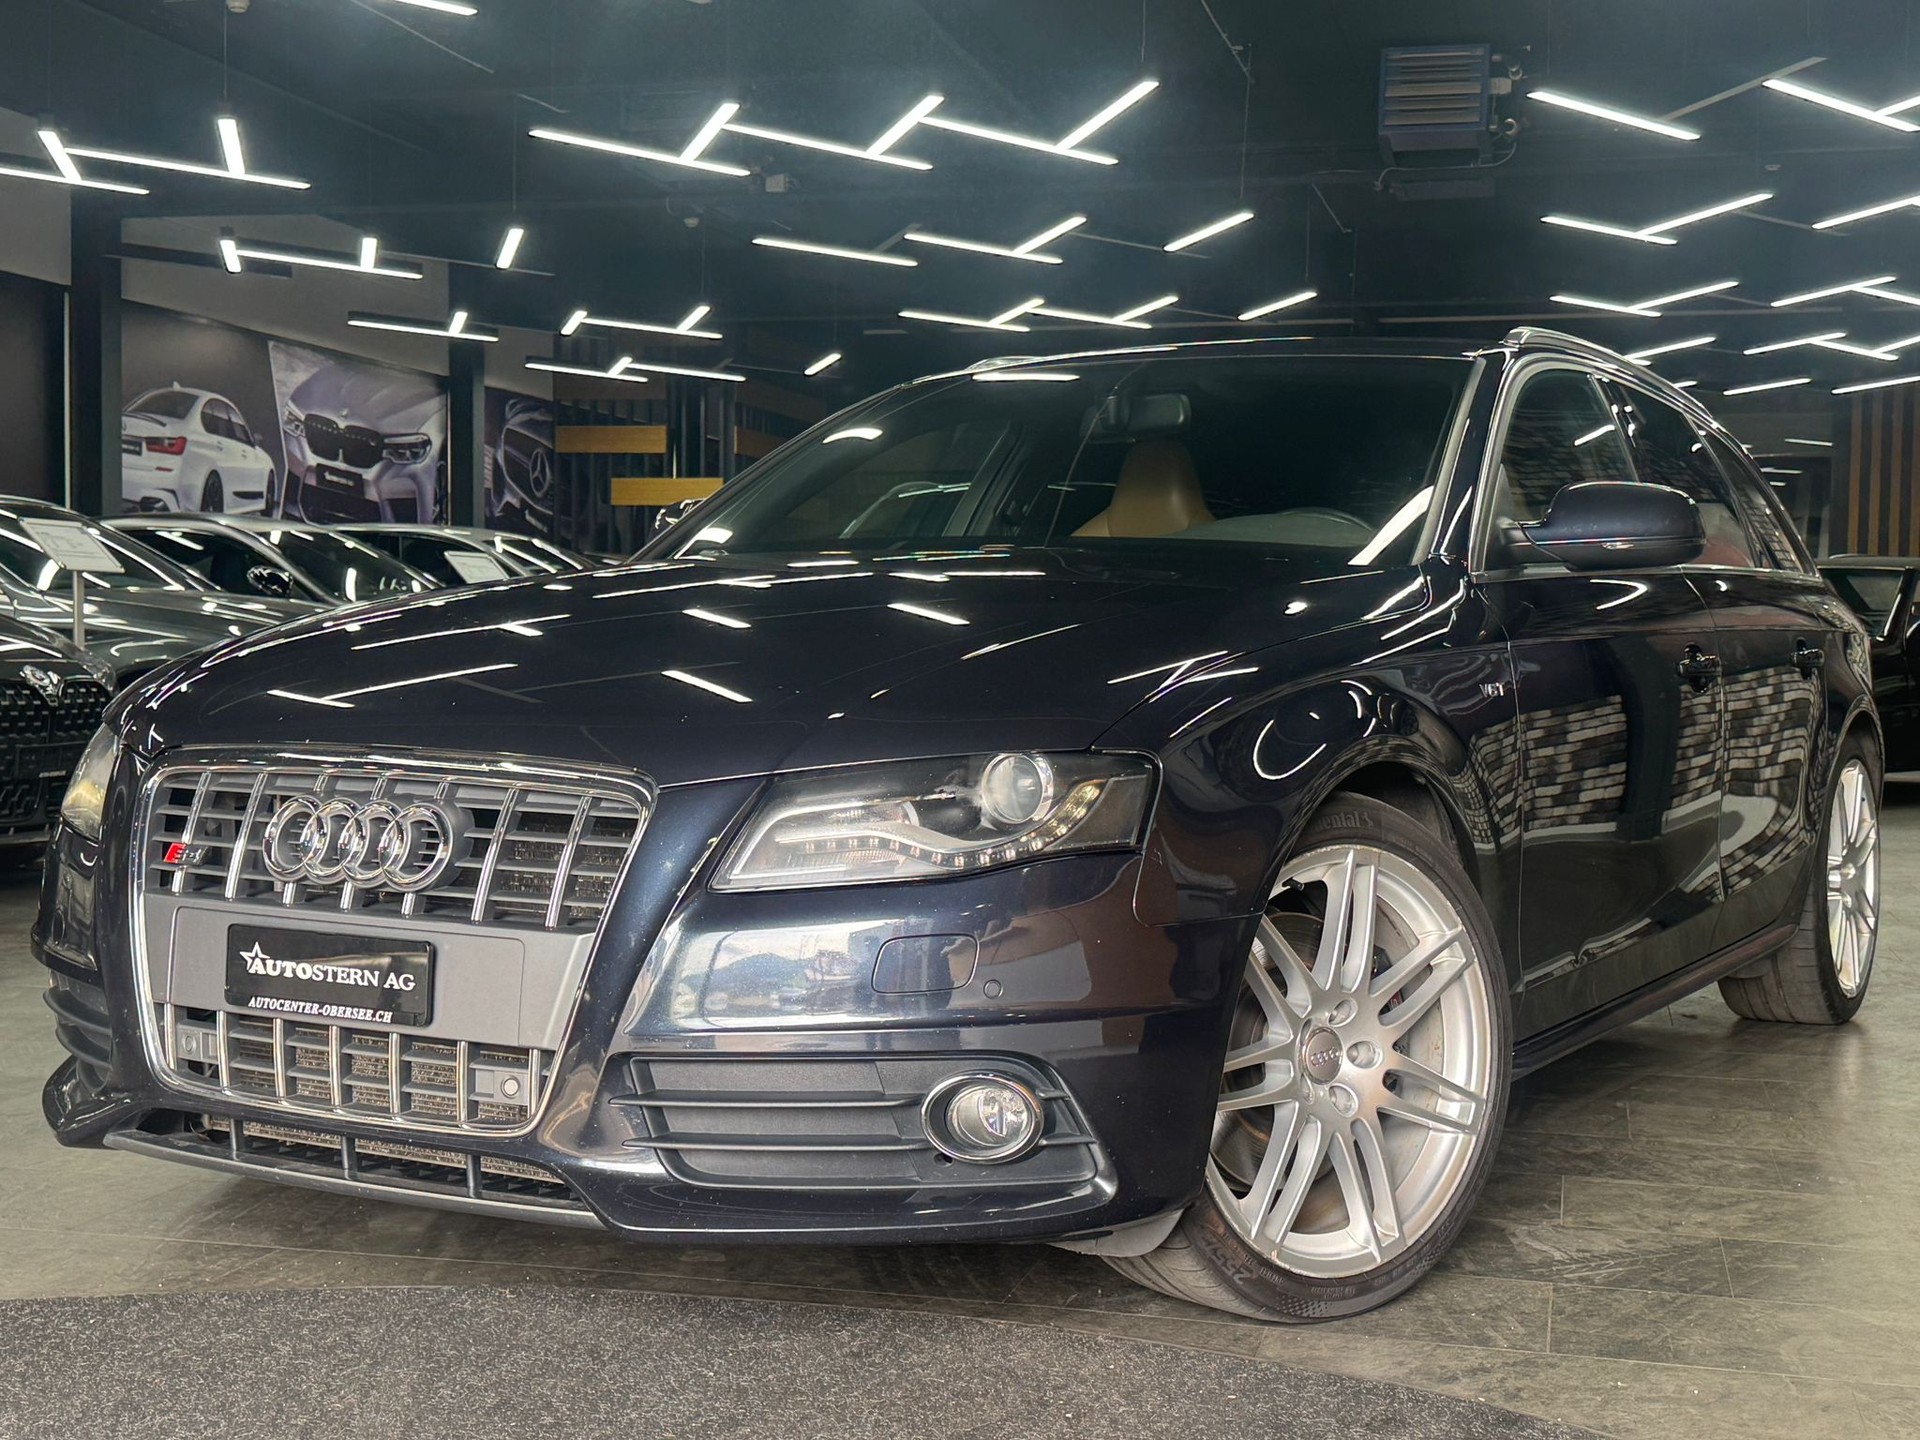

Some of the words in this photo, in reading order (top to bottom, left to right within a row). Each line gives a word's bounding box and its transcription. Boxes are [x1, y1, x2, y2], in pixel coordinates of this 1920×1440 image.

[248, 957, 380, 988] AUTOSTERN
[383, 971, 416, 991] AG
[248, 996, 393, 1024] AUTOCENTER-OBERSEE.CH
